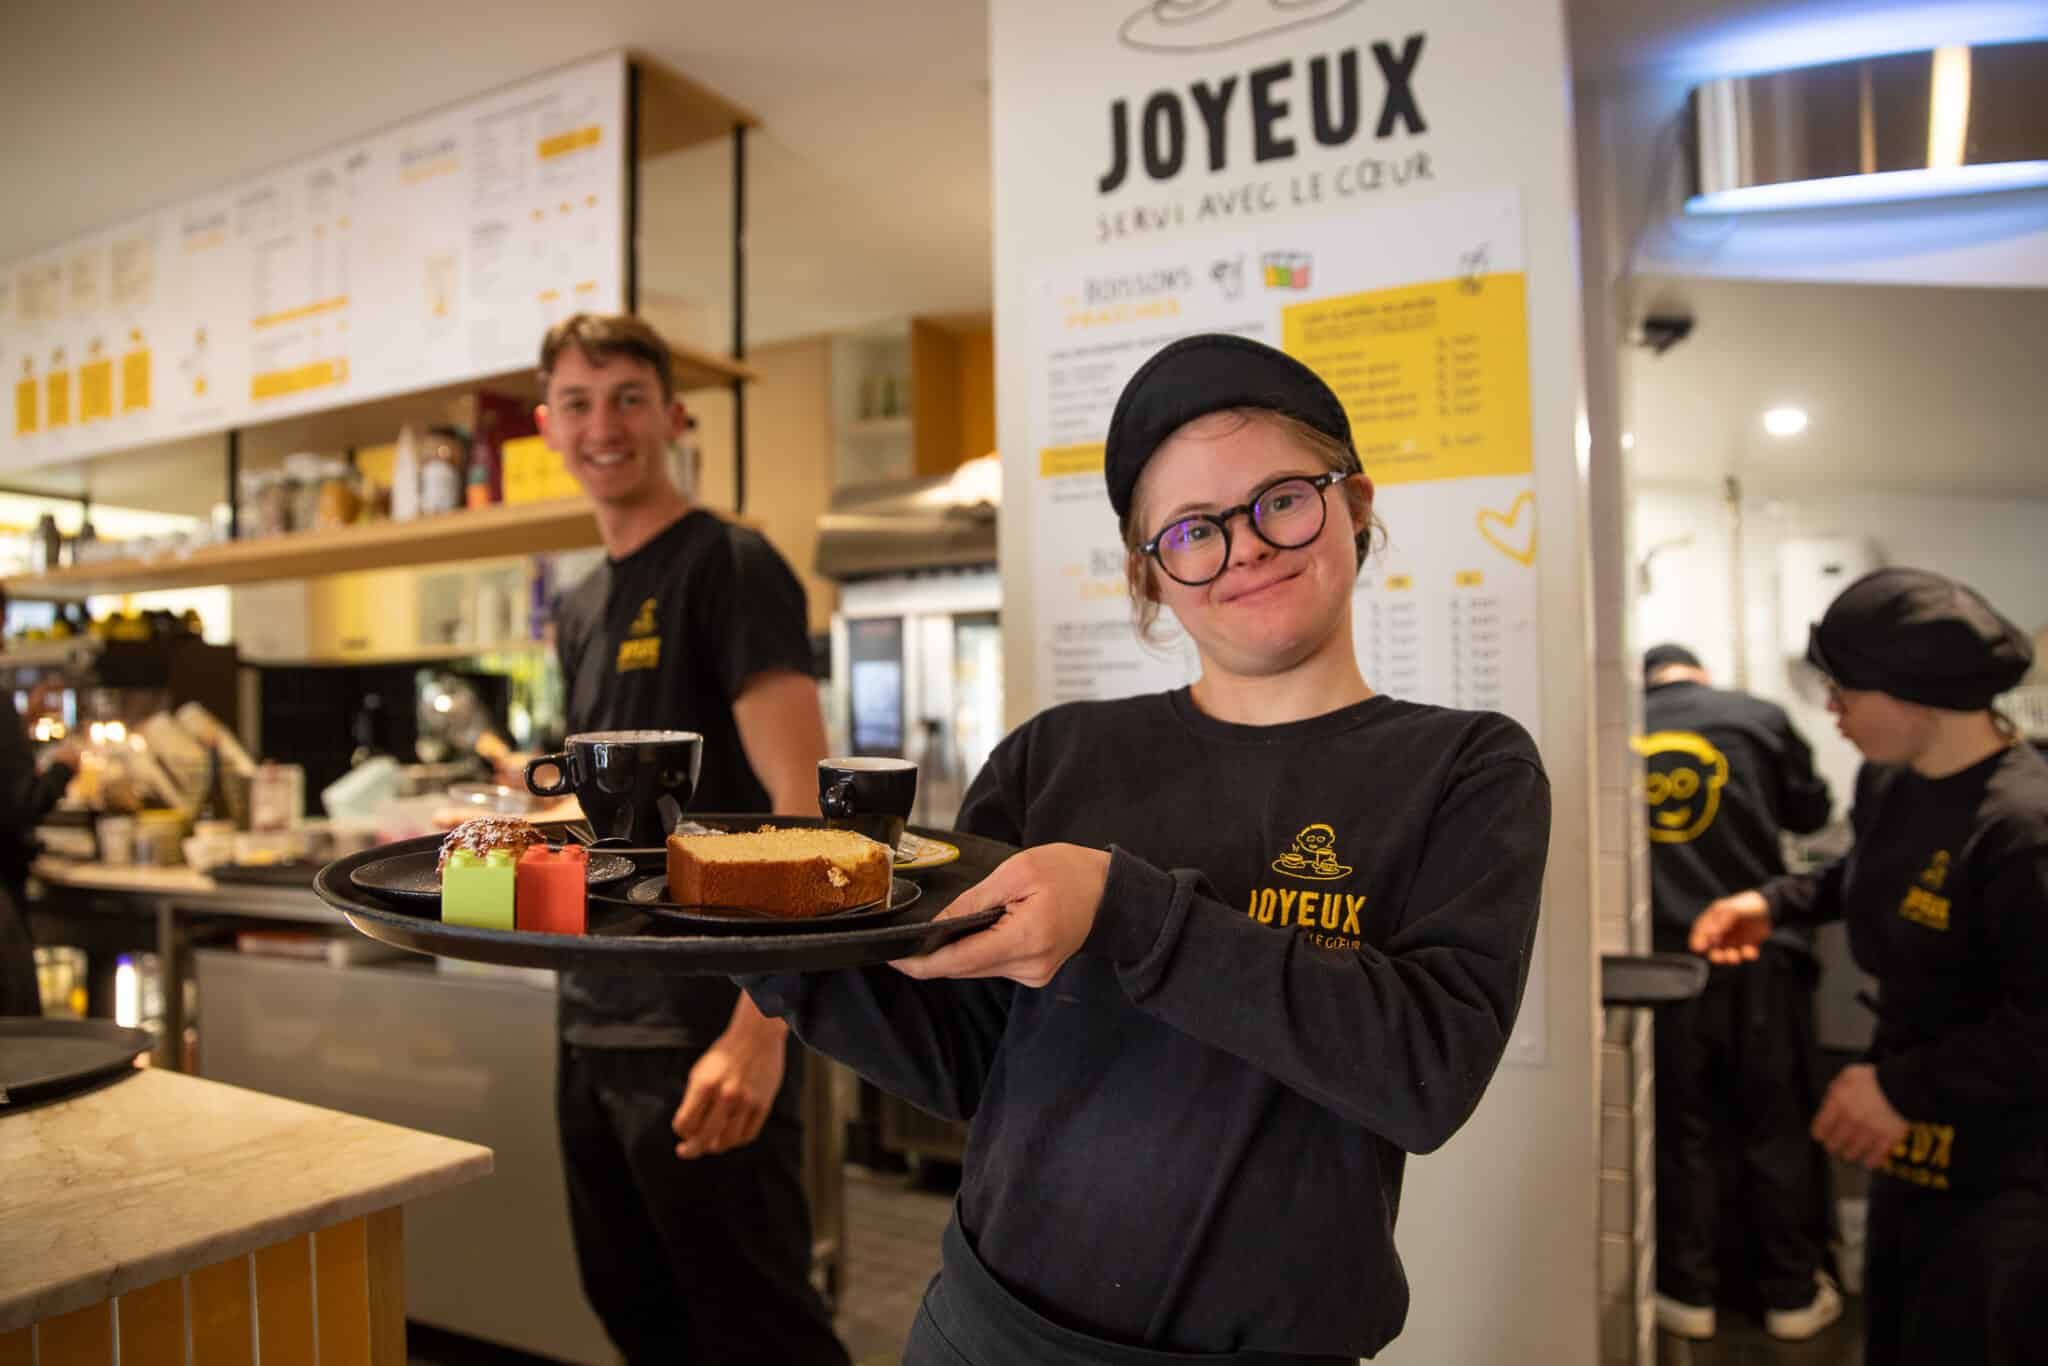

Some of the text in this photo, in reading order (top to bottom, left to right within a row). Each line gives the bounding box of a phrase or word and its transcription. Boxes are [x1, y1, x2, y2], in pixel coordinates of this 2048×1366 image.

[1098, 33, 1428, 195] JOYEUX
[1097, 152, 1434, 244] SERVI AVEC LE CŒUR
